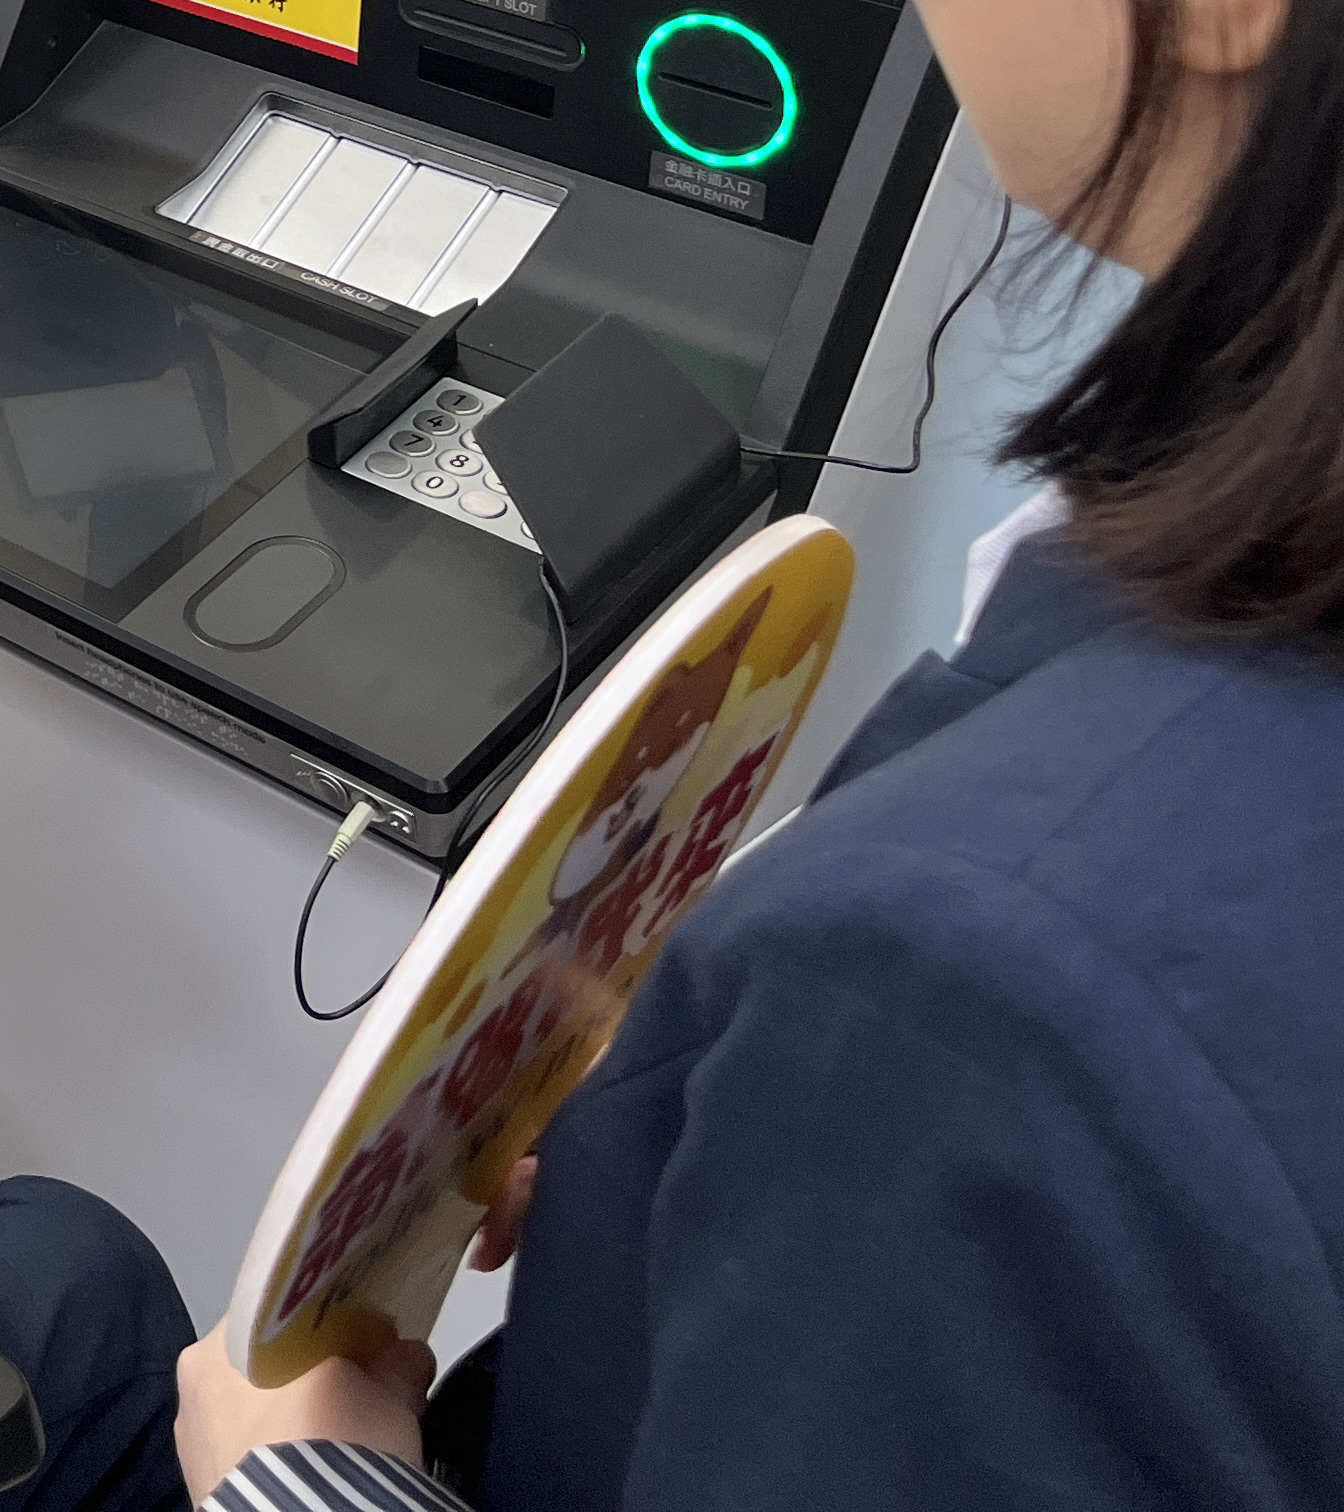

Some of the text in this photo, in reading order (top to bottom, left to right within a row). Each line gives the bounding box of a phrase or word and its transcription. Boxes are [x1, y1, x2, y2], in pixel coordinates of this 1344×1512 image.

[664, 176, 750, 210] CARD ENTRY
[300, 271, 379, 304] CASH SLOT
[452, 394, 467, 407] 1
[426, 414, 445, 428] 4
[403, 433, 425, 447] 7
[449, 454, 470, 468] 8
[425, 476, 445, 489] 0
